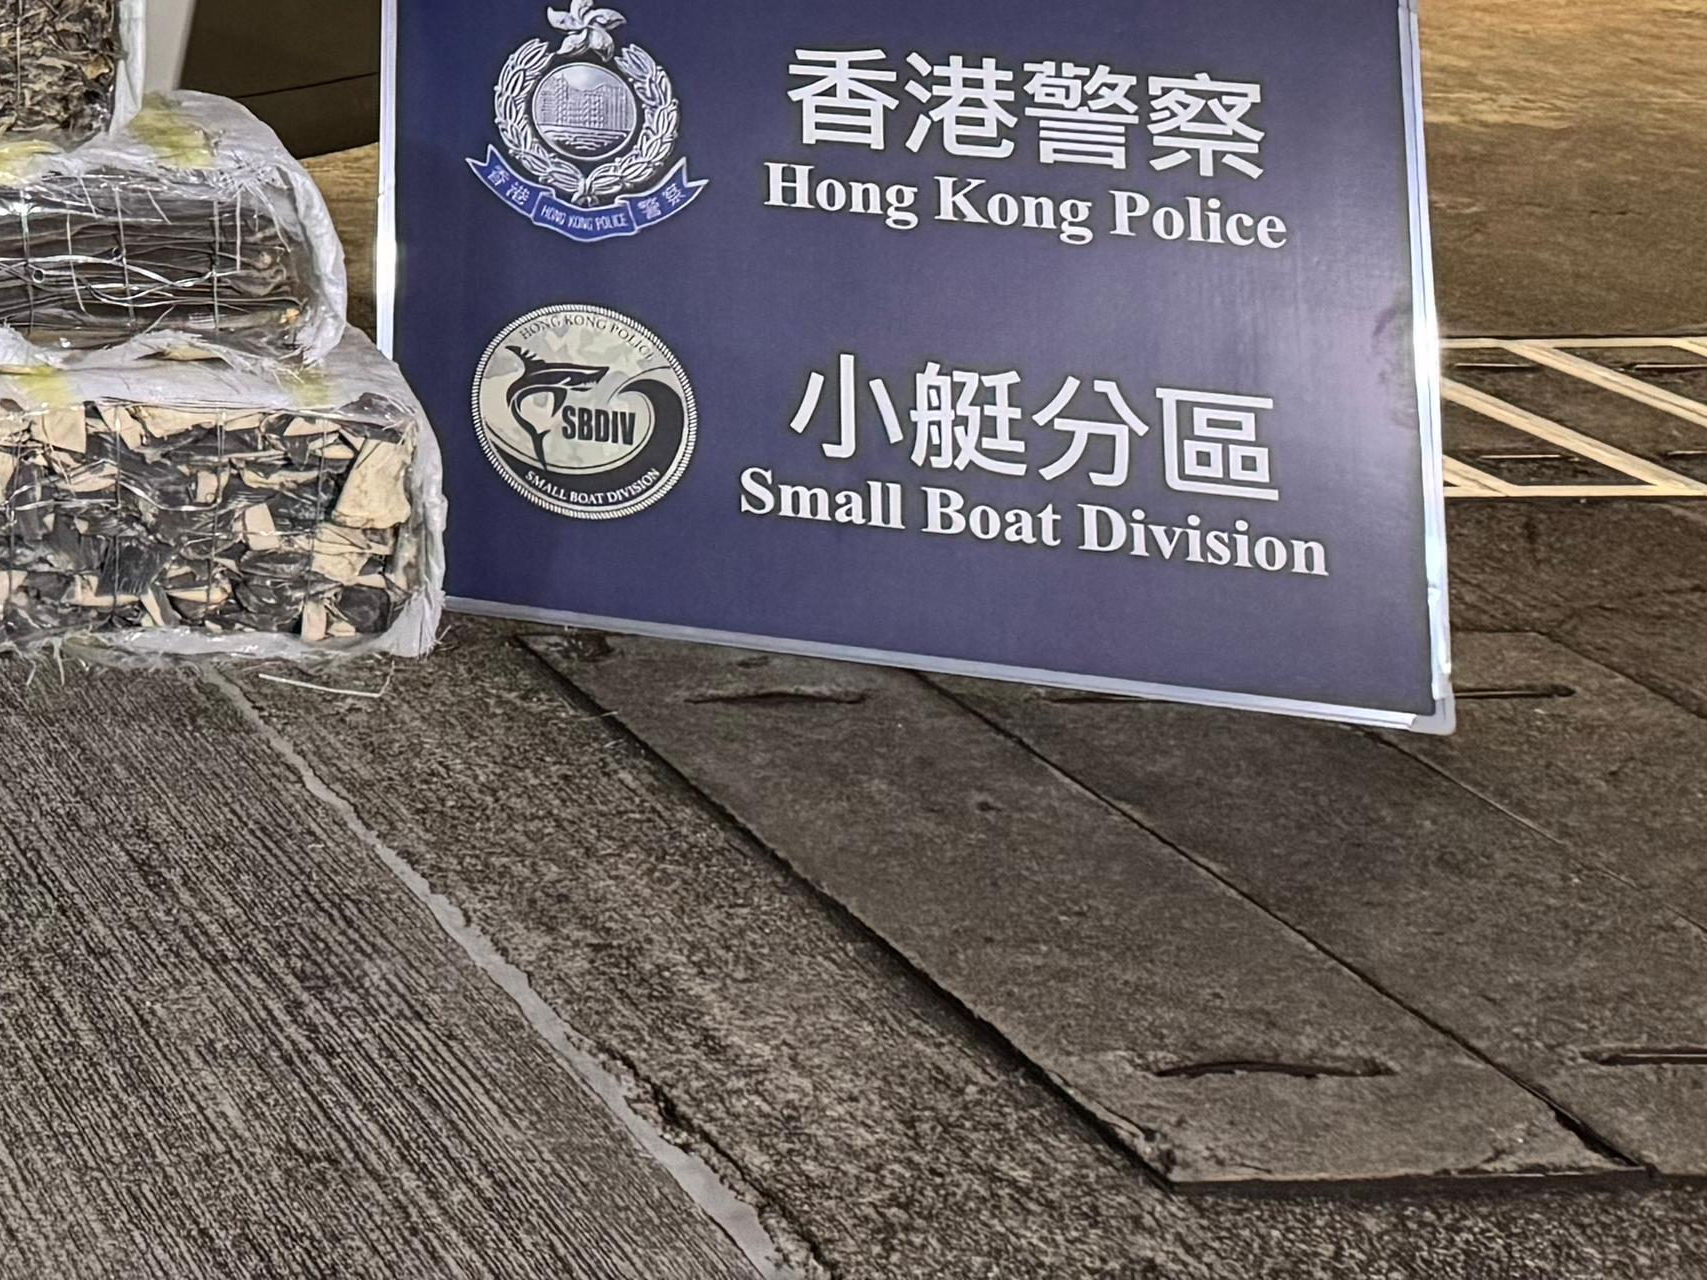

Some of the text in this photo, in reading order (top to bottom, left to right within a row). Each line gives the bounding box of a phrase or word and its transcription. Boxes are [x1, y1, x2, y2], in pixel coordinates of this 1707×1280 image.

[787, 48, 1265, 180] 香港警察
[540, 204, 628, 231] HONG KONG POLICE
[764, 161, 1288, 250] Hong Kong Police
[519, 316, 561, 340] HONG
[565, 314, 606, 330] KONG
[561, 405, 637, 446] SBDIV
[790, 354, 1280, 501] 小艇分區
[525, 467, 661, 505] SMALL BOAT DIVISION
[740, 467, 1330, 577] Small Boat Division
